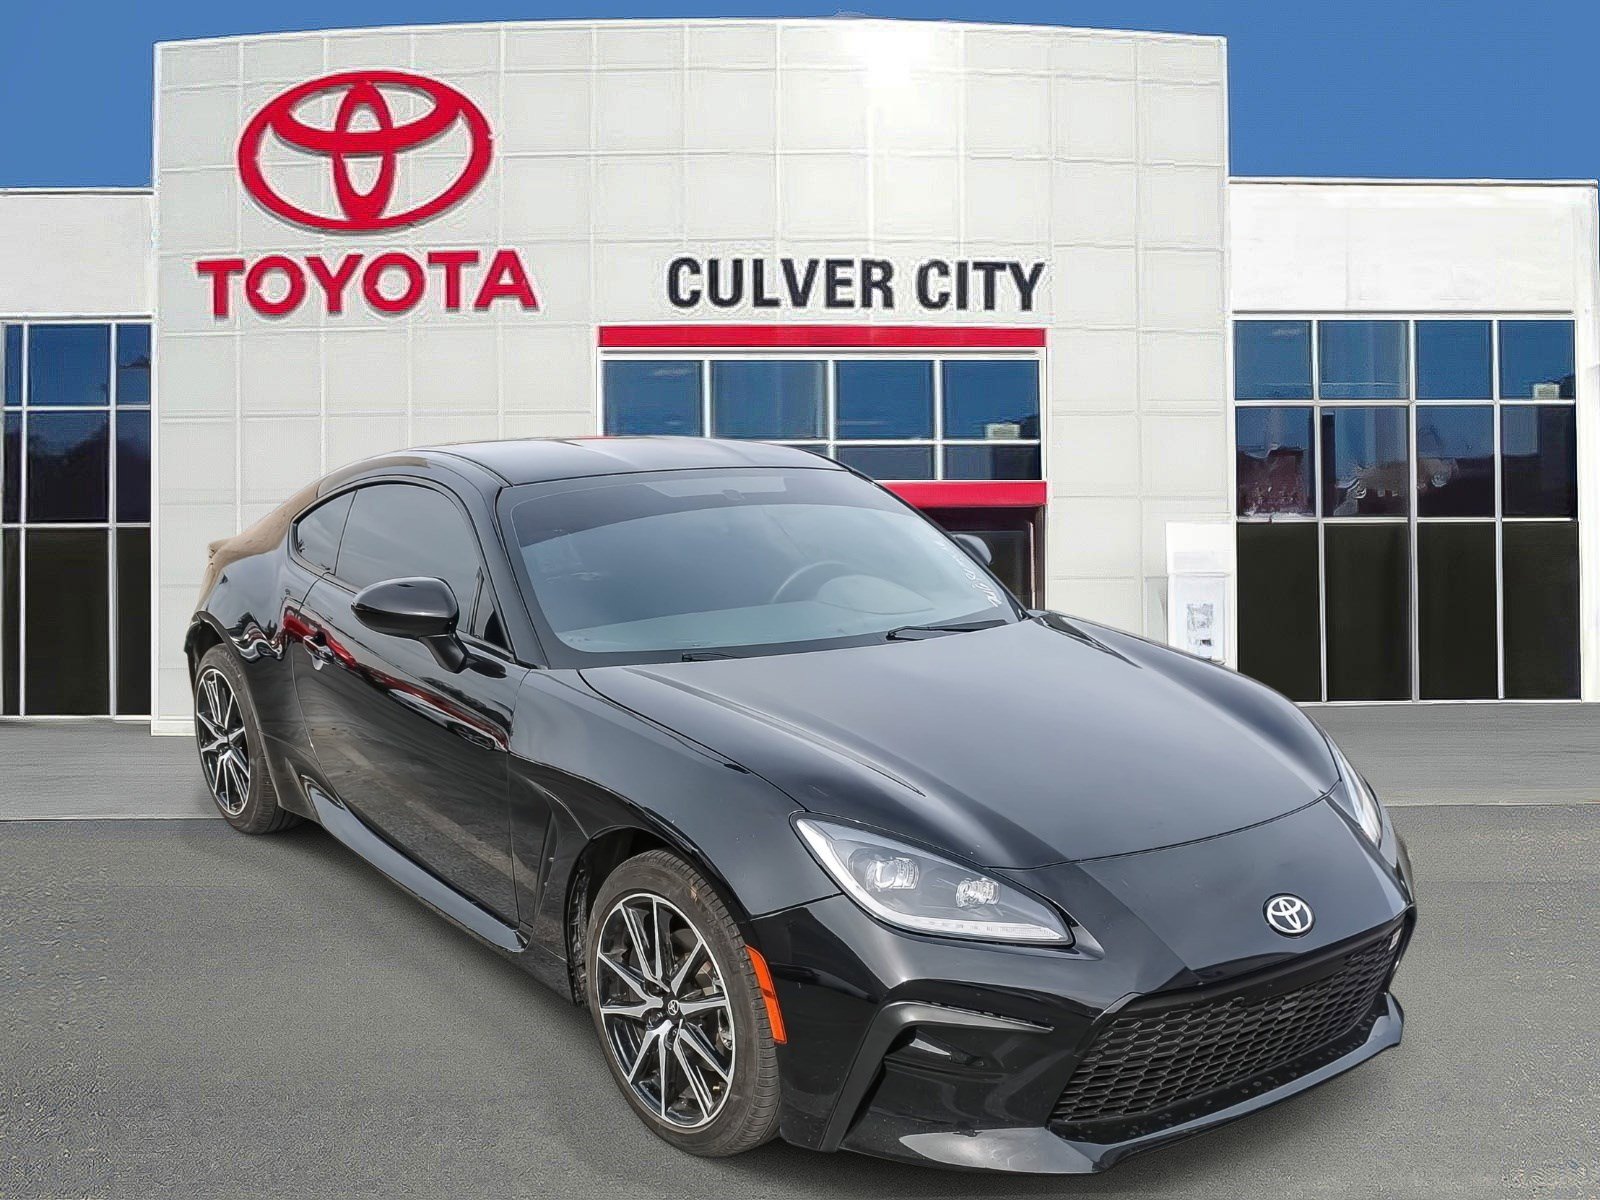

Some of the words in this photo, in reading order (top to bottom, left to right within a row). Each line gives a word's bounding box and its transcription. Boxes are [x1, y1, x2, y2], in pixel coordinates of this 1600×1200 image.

[197, 249, 538, 317] TOYOTA
[669, 257, 894, 309] CULVER
[917, 259, 1044, 311] CITY
